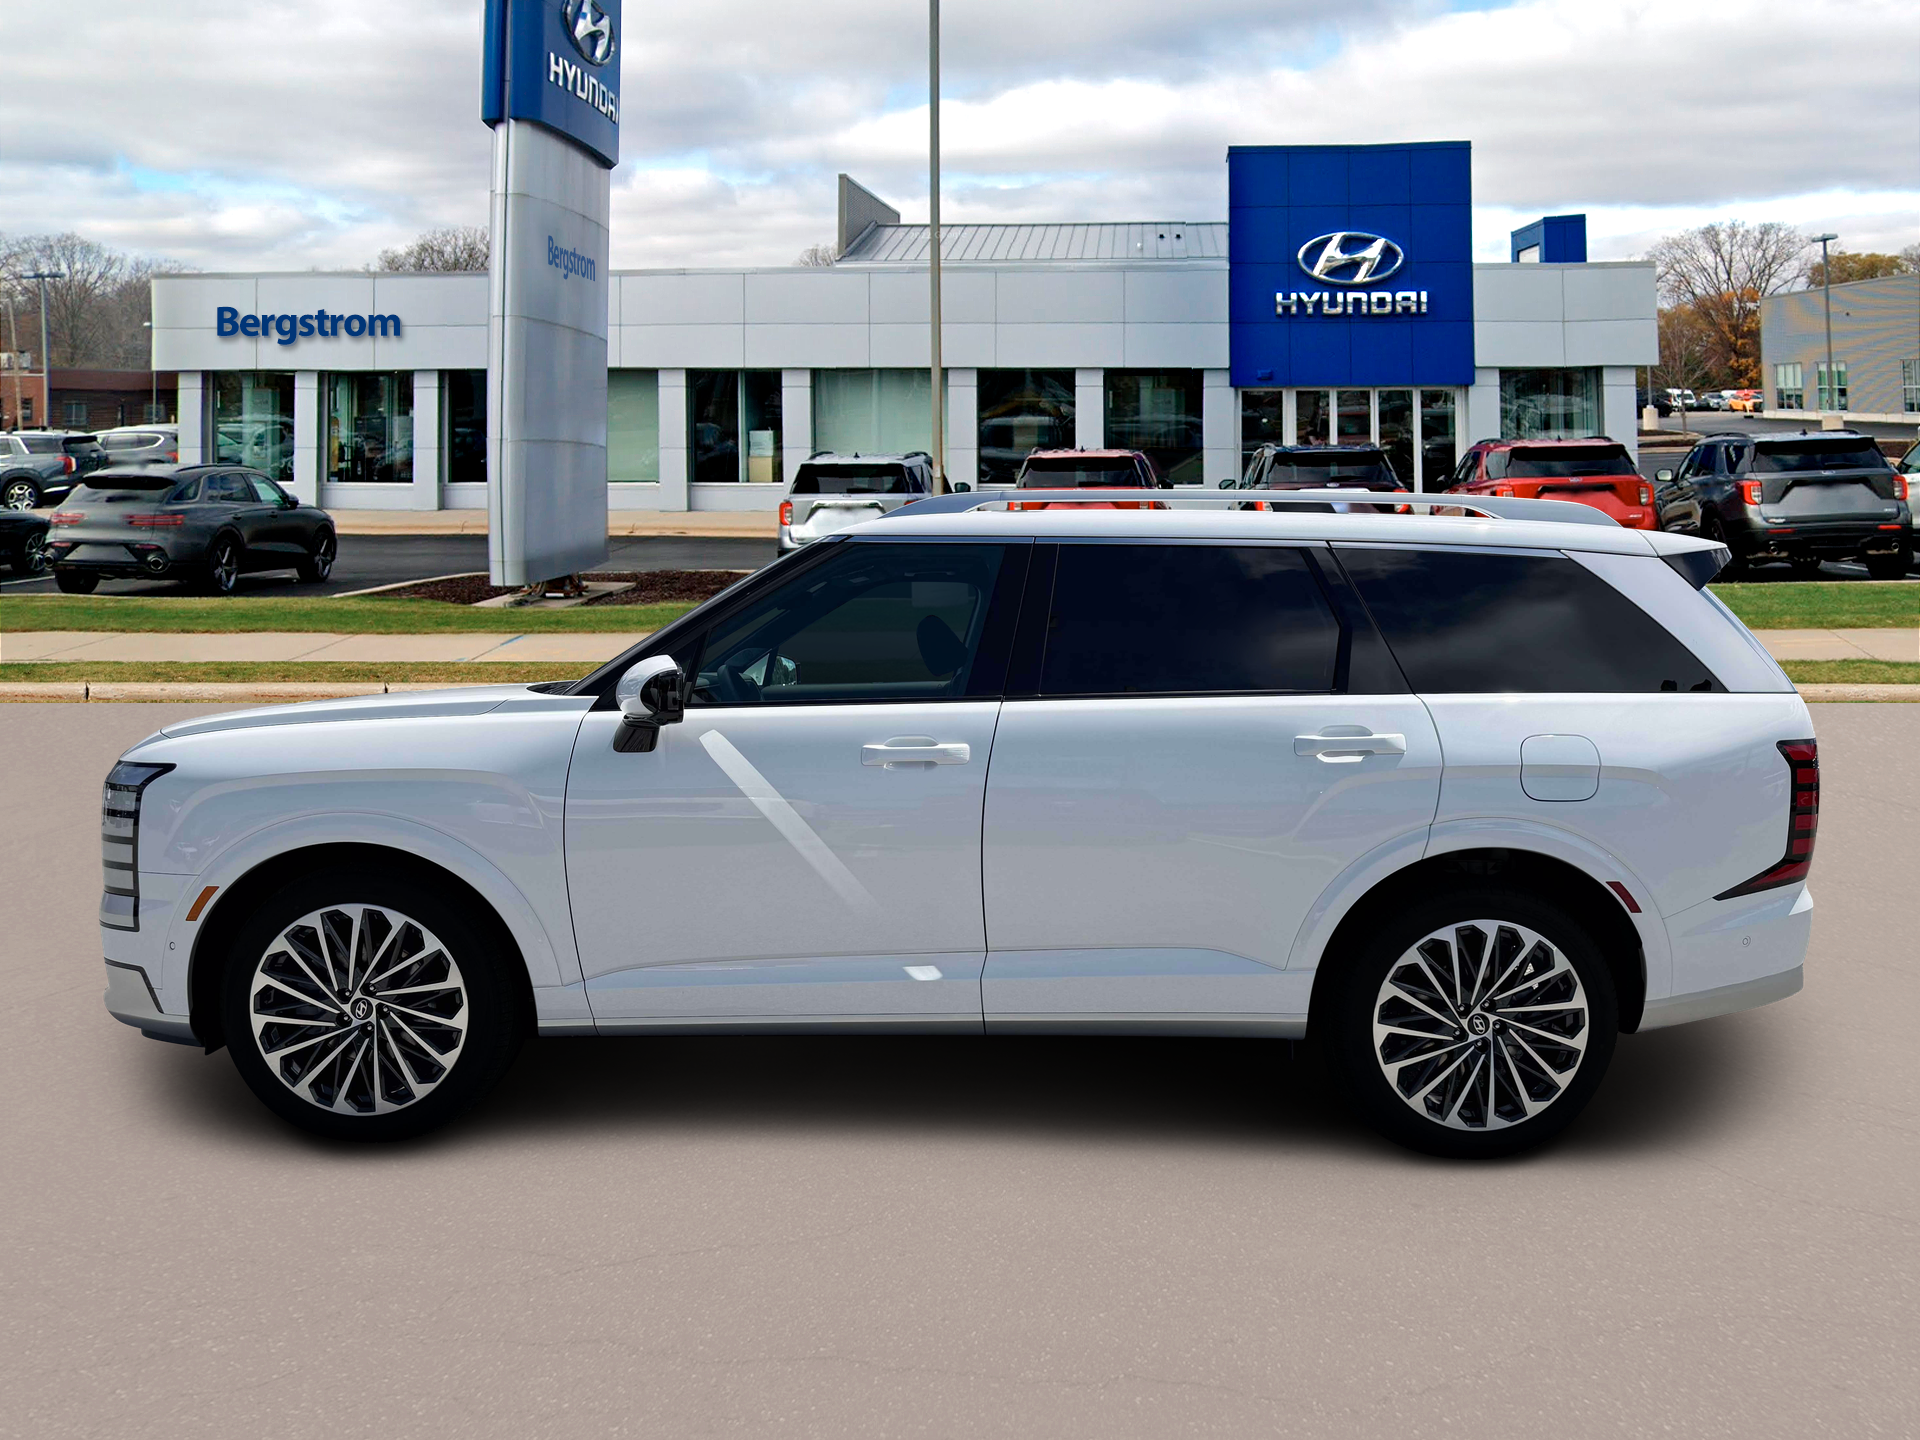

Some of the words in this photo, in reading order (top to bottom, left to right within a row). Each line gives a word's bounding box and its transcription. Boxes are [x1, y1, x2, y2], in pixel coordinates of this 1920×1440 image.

[549, 51, 619, 124] HYUNDAI
[547, 235, 596, 282] Bergstrom
[1275, 290, 1429, 315] HYUNDAI
[216, 306, 402, 346] Bergstrom
